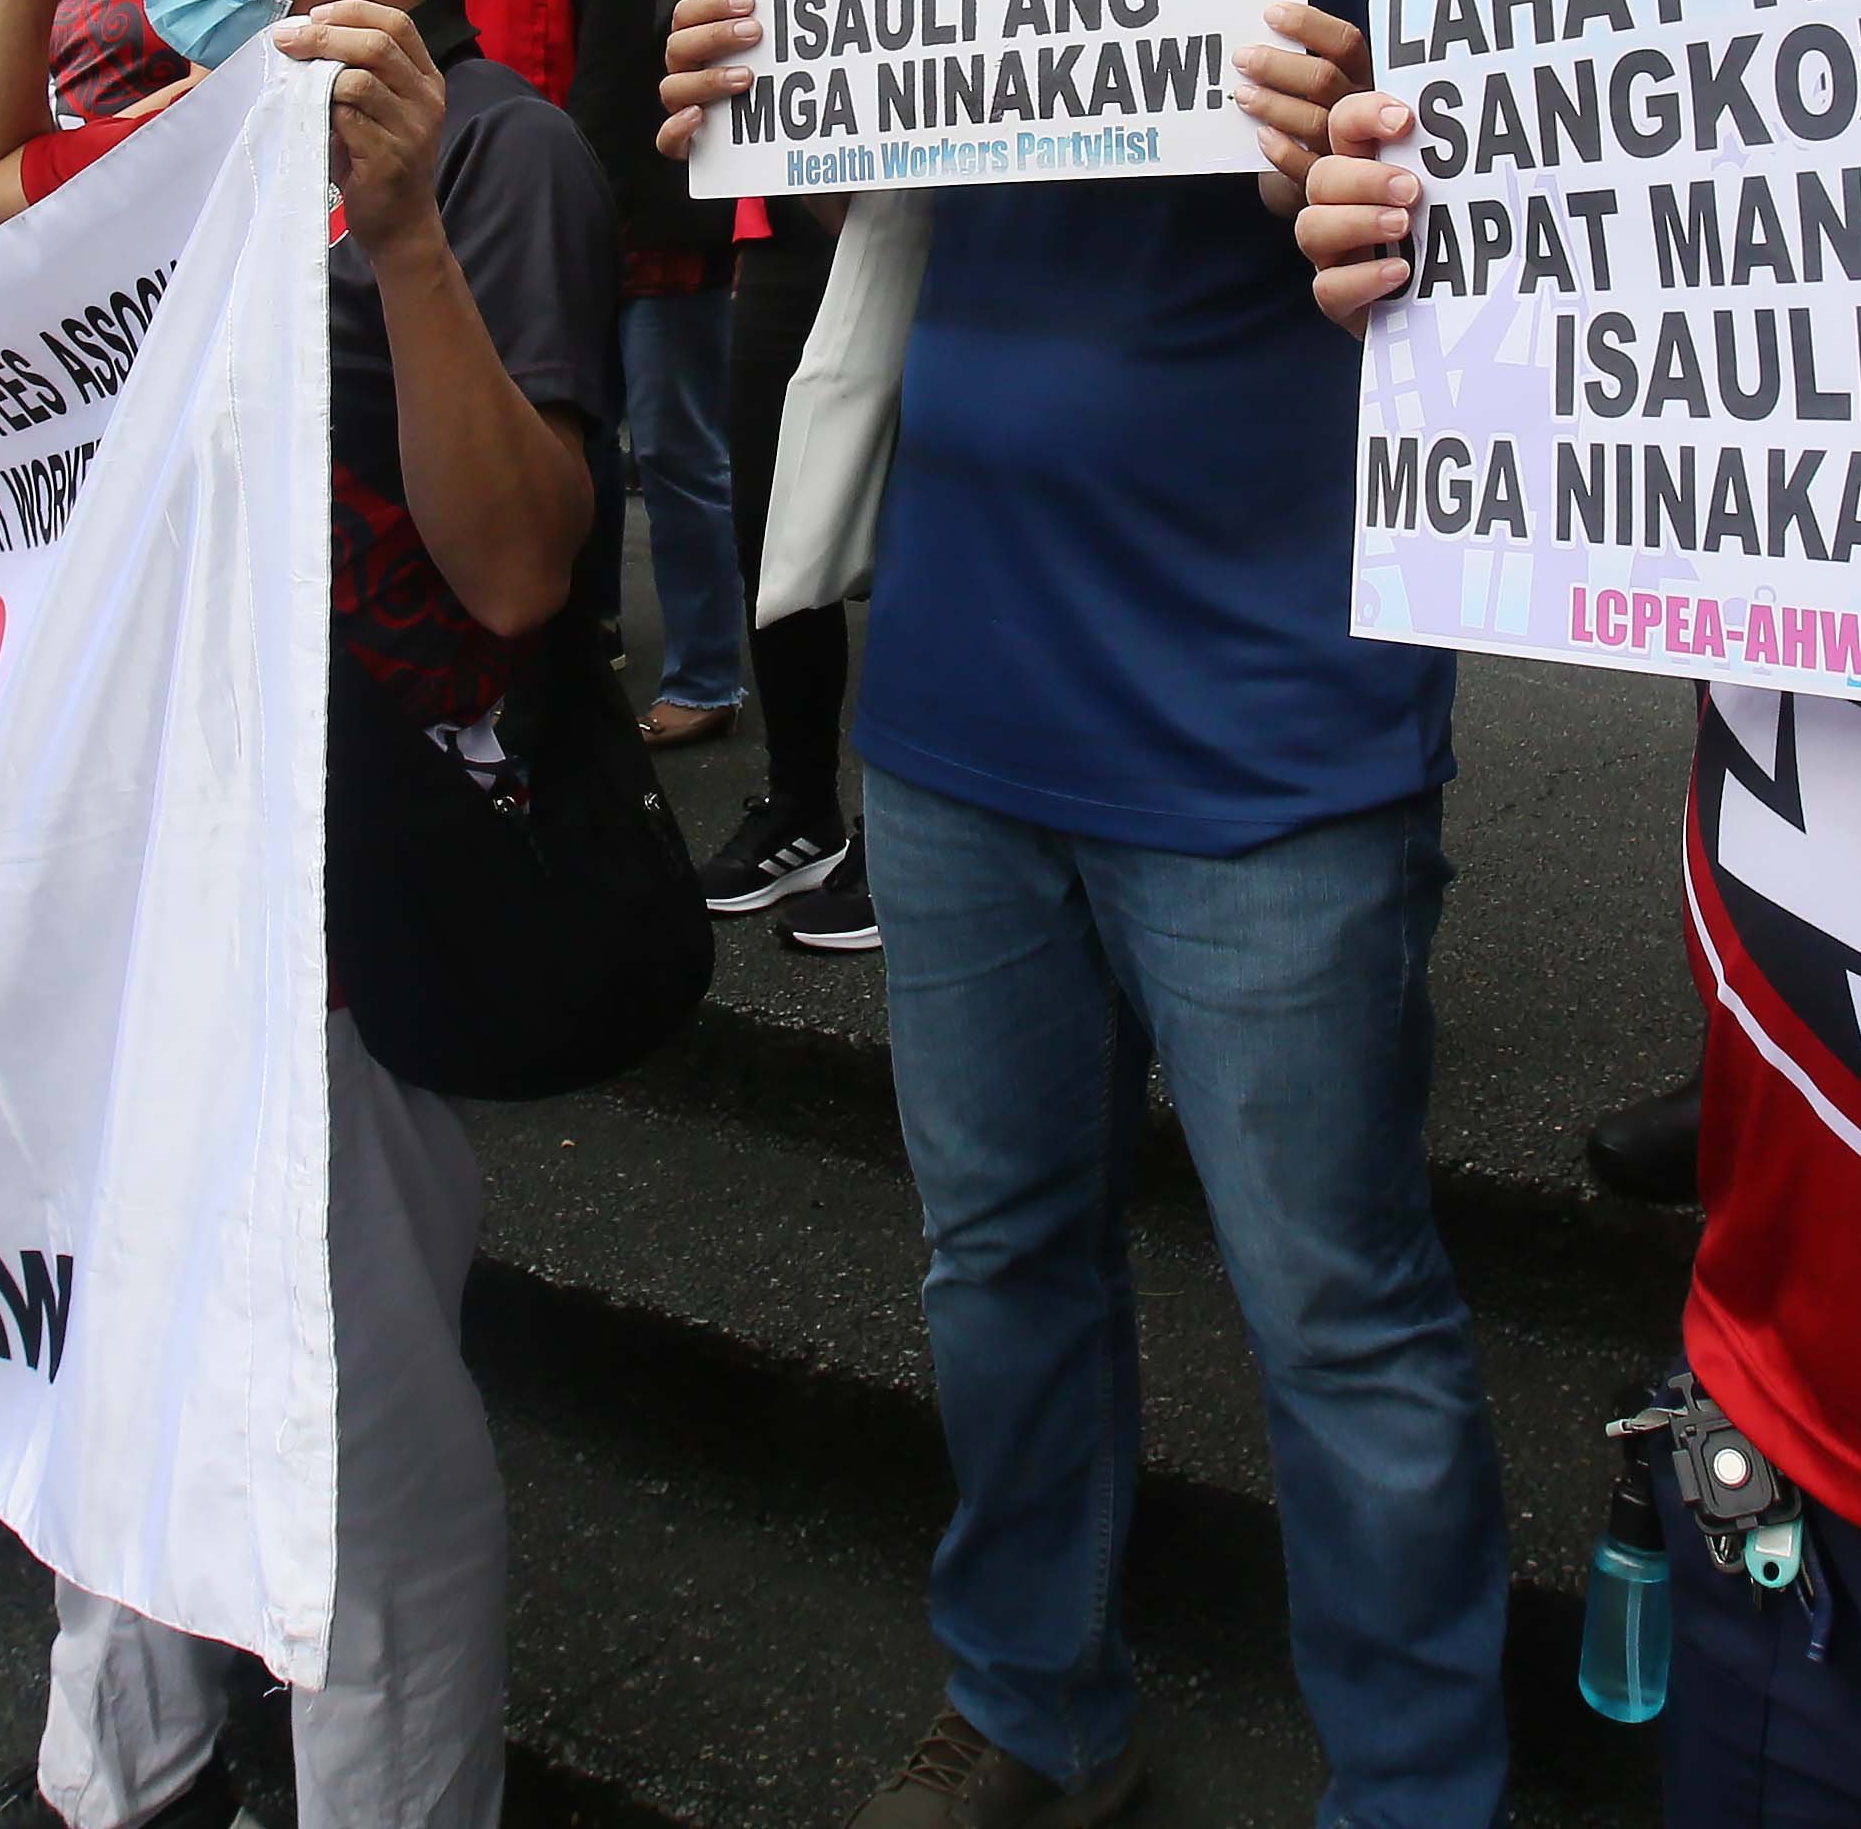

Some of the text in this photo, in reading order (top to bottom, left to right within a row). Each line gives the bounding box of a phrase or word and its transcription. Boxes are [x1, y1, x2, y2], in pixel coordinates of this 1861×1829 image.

[731, 33, 1223, 145] MGA NINAKAW!
[787, 126, 1160, 186] Health Workers Partylist
[1365, 434, 1527, 539] MGA
